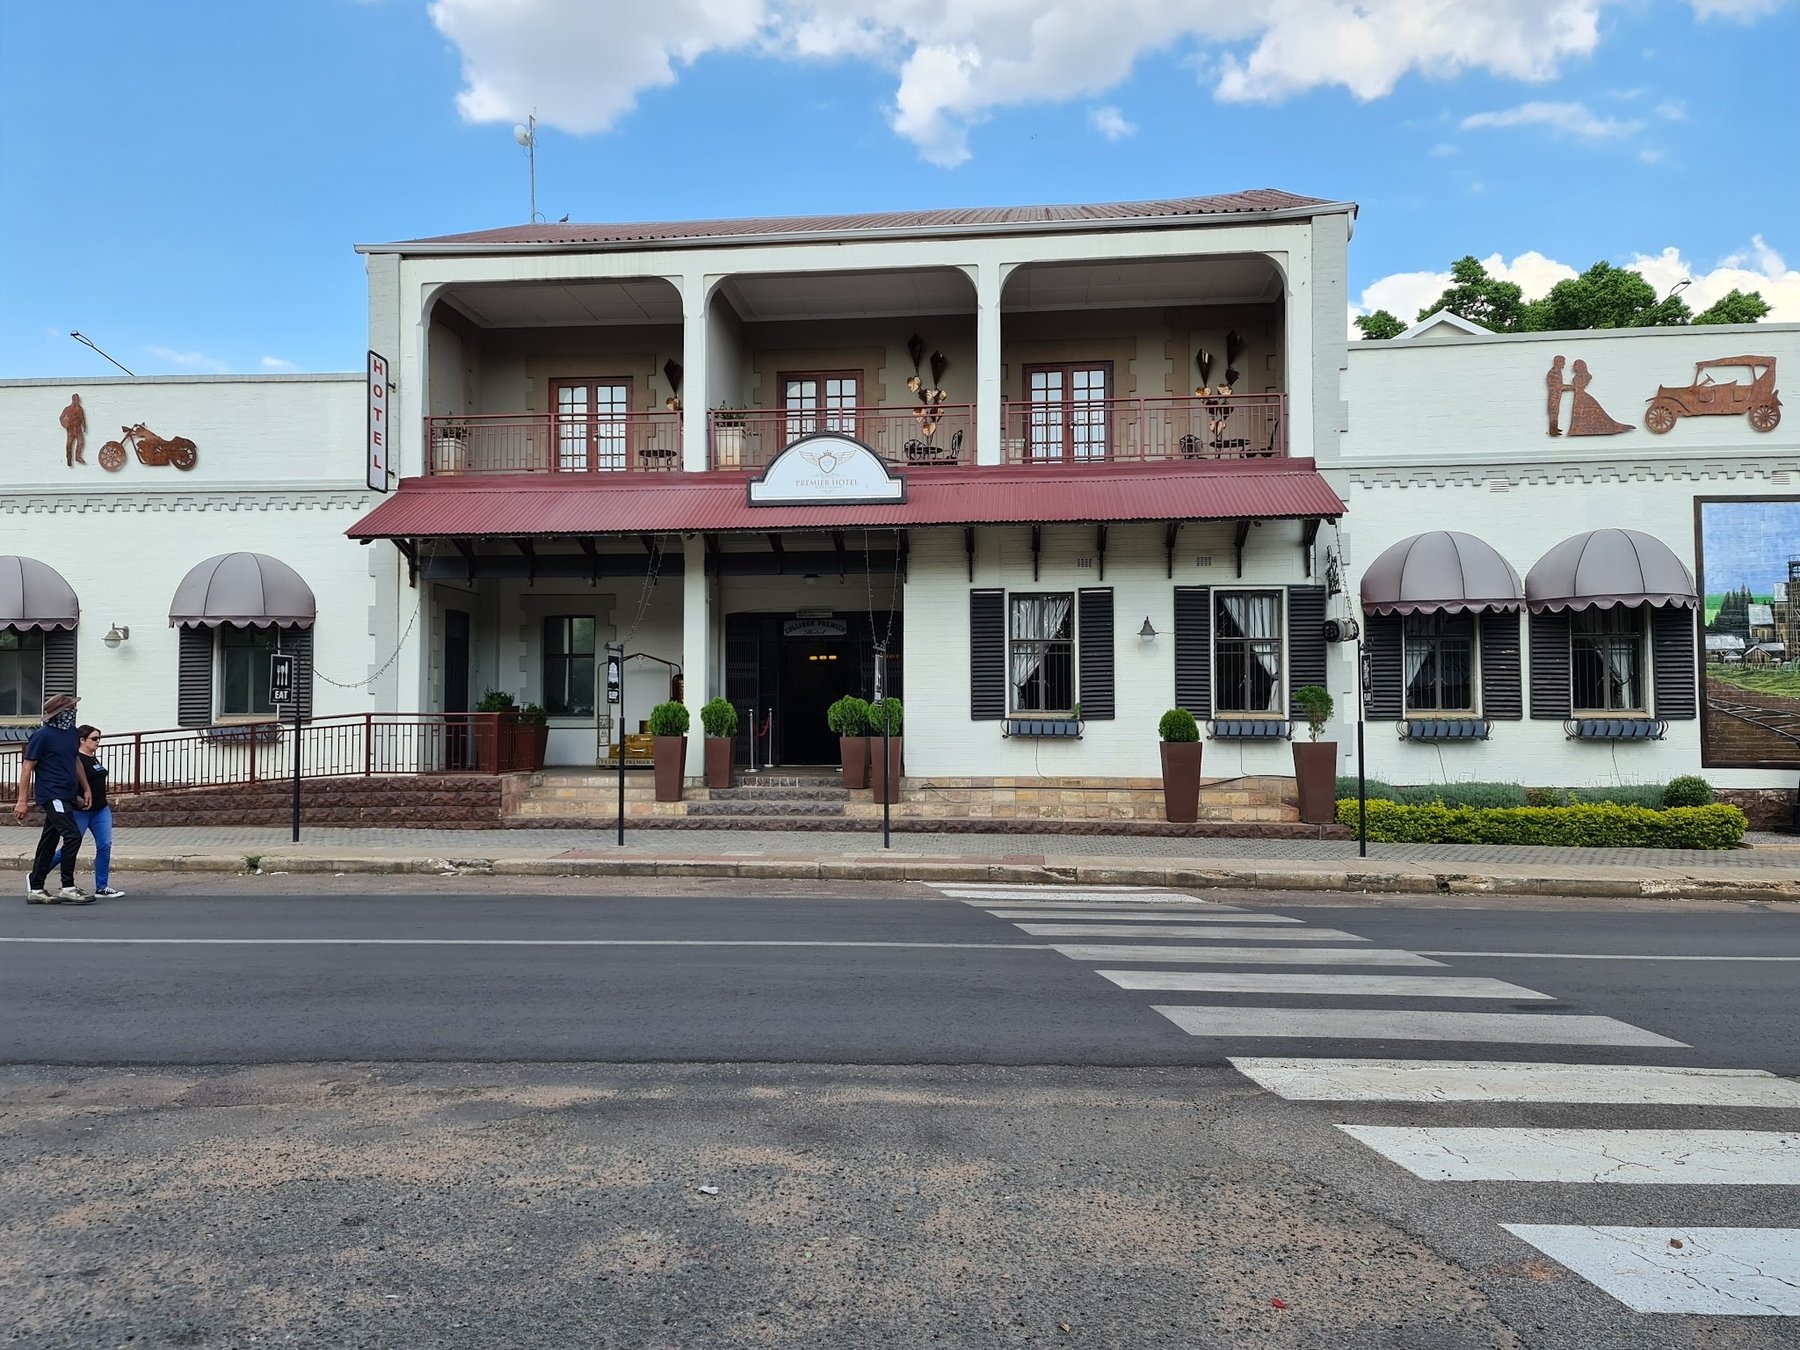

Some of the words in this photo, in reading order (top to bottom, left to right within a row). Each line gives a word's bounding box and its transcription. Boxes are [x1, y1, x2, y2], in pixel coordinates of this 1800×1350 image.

[373, 359, 383, 470] HOTEL
[795, 479, 830, 487] PREMIER
[832, 479, 858, 487] HOTEL
[274, 690, 289, 700] EAT
